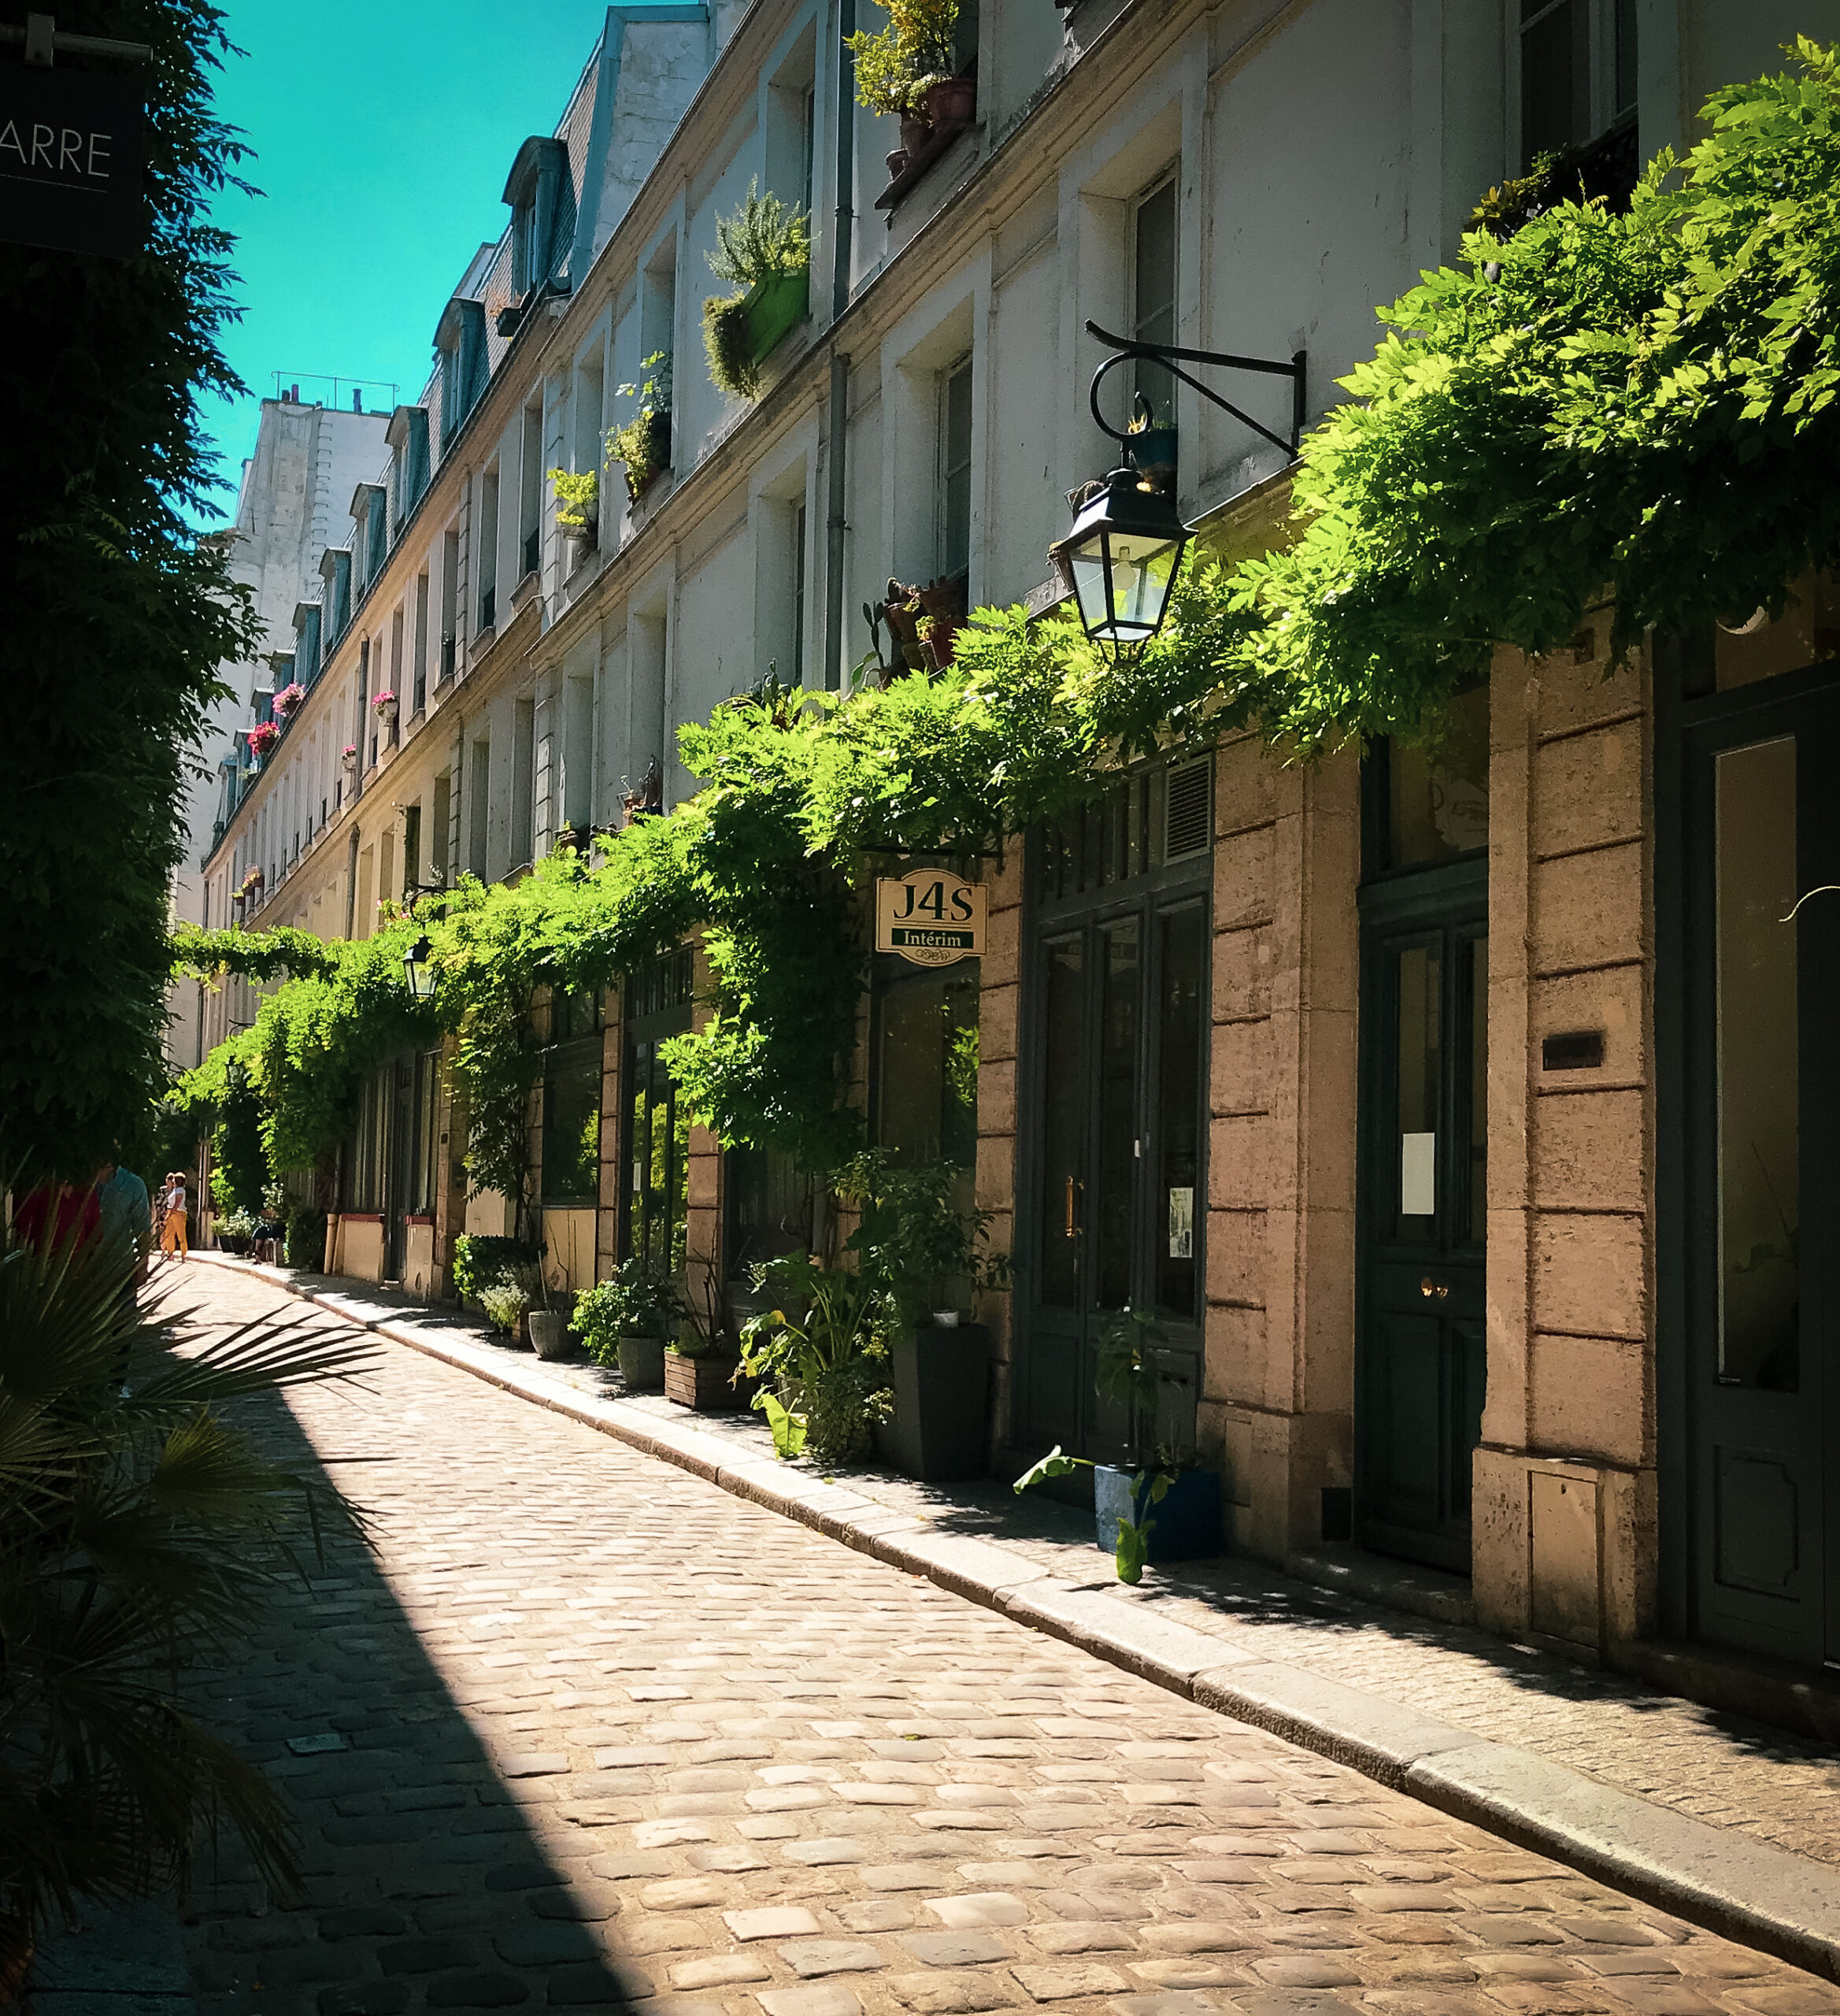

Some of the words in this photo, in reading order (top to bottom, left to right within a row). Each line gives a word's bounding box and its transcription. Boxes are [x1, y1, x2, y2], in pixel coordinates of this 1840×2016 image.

[0, 120, 112, 177] ARRE
[893, 881, 973, 921] J4S
[904, 931, 961, 947] Intérim
